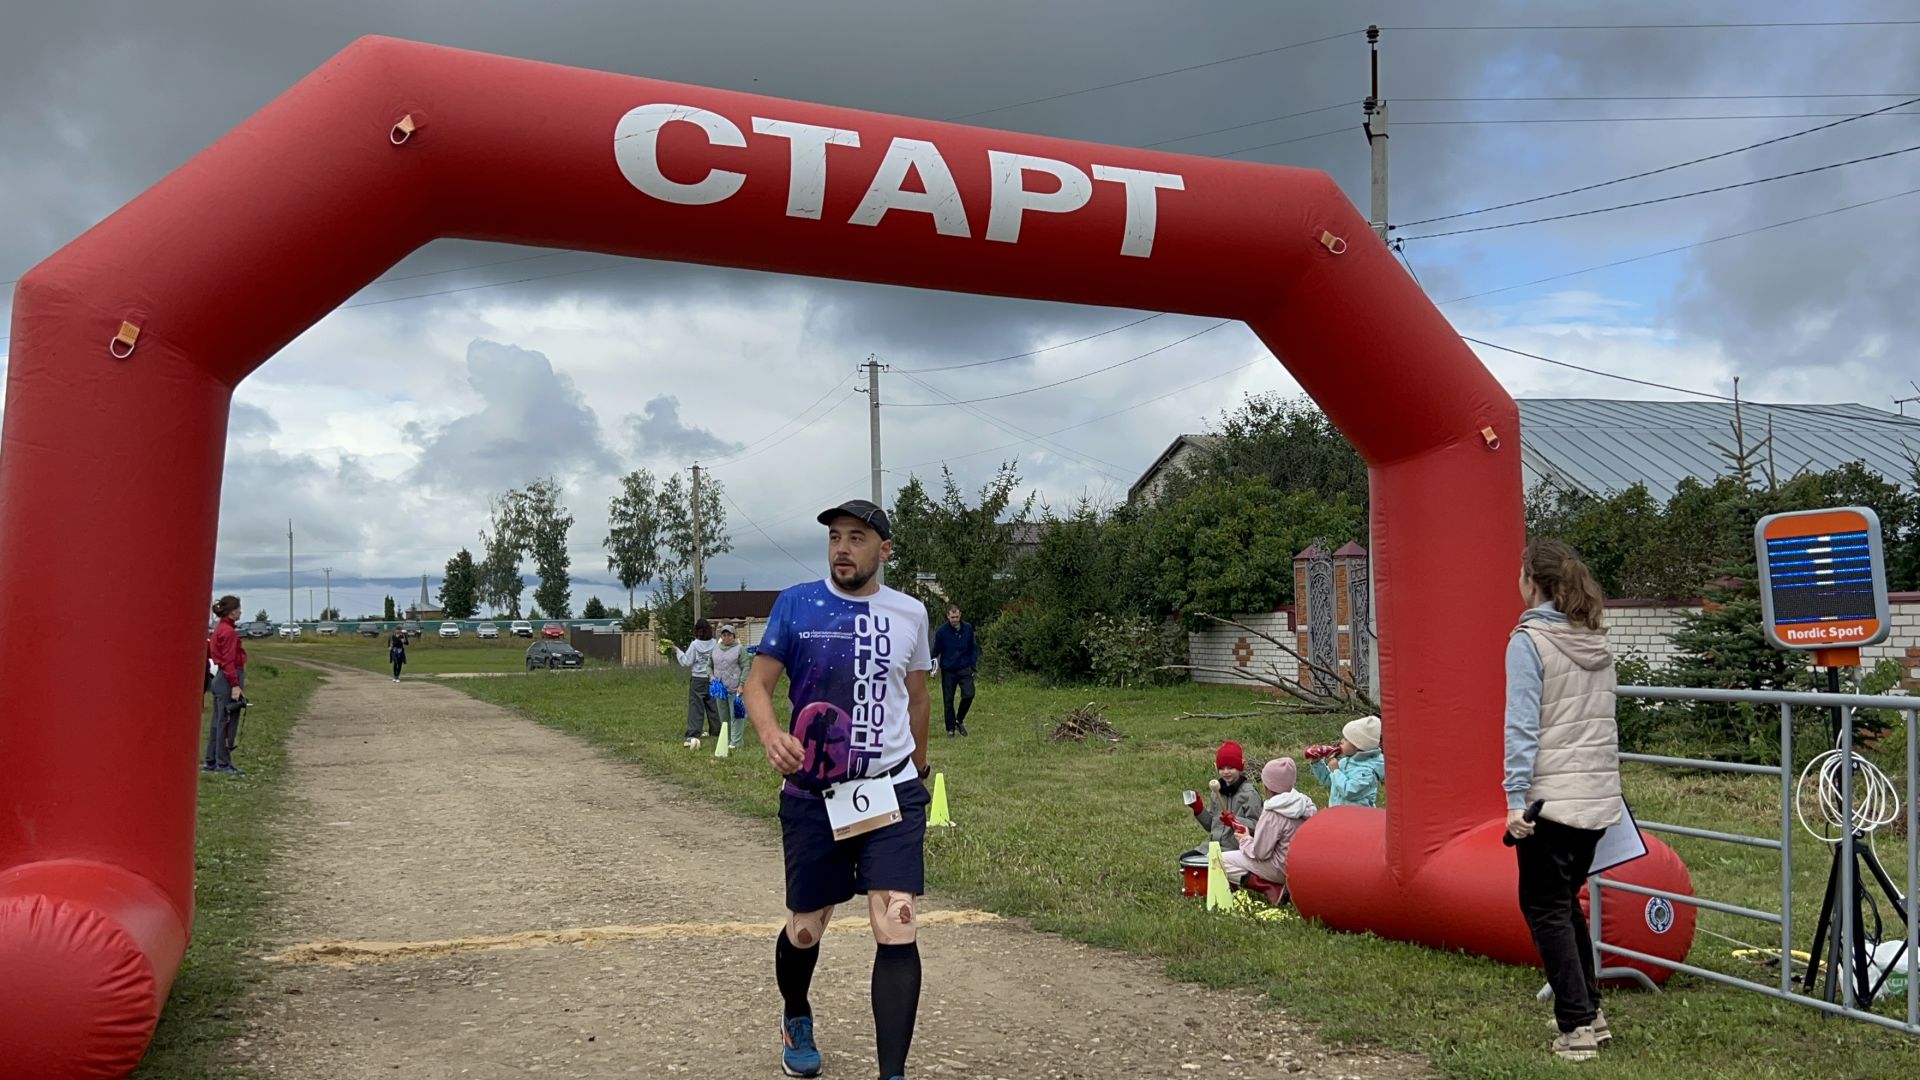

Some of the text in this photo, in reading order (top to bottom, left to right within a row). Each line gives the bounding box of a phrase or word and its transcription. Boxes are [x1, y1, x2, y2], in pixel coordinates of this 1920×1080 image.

[613, 103, 1185, 259] СТАРТ
[798, 631, 810, 639] 10
[1829, 625, 1864, 639] Sport
[850, 613, 872, 748] ПРОСТО
[869, 615, 891, 748] КОСМОС
[852, 783, 870, 813] 6
